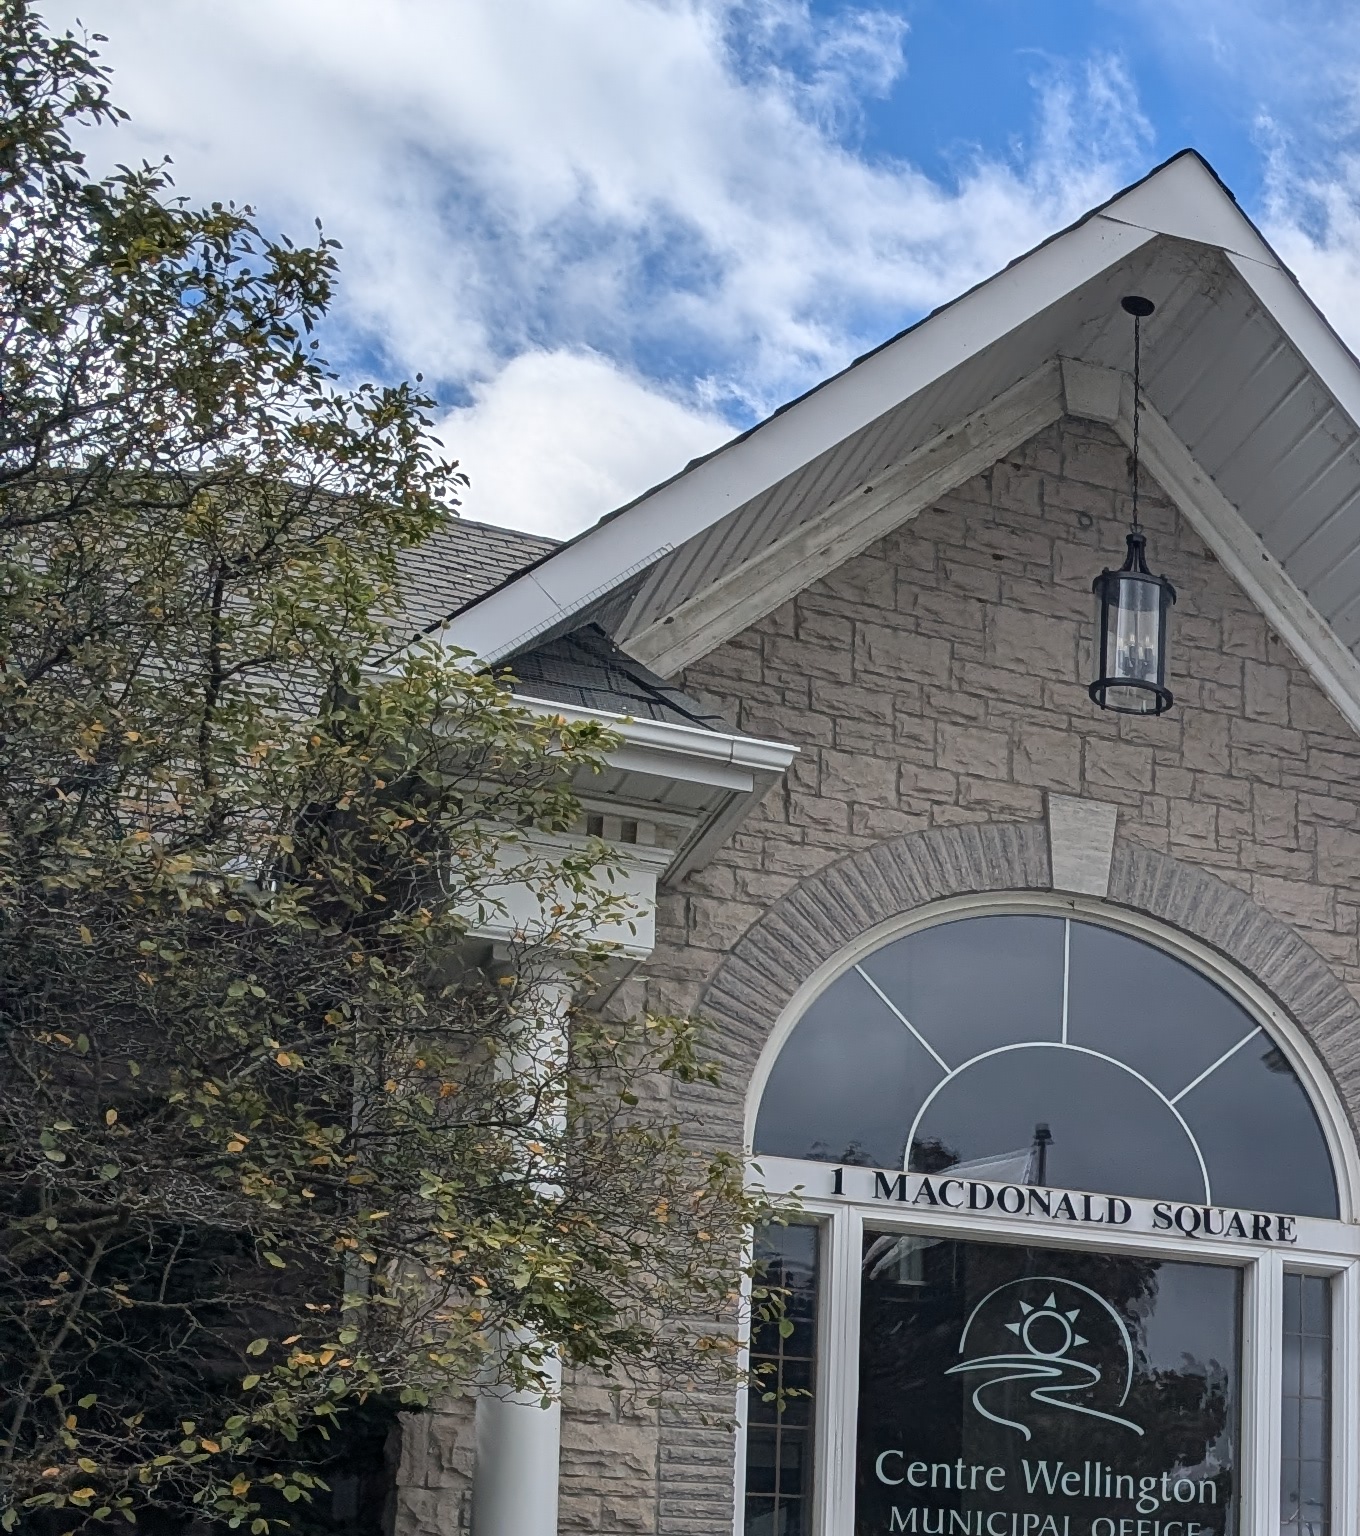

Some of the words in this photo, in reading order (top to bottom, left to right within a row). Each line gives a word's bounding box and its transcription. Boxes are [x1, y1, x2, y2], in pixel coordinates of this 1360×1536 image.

[830, 1167, 844, 1196] 1
[872, 1170, 1132, 1225] MACDONALD
[1151, 1202, 1297, 1244] SQUARE
[875, 1449, 1006, 1493] Centre
[1021, 1457, 1217, 1513] Wellington
